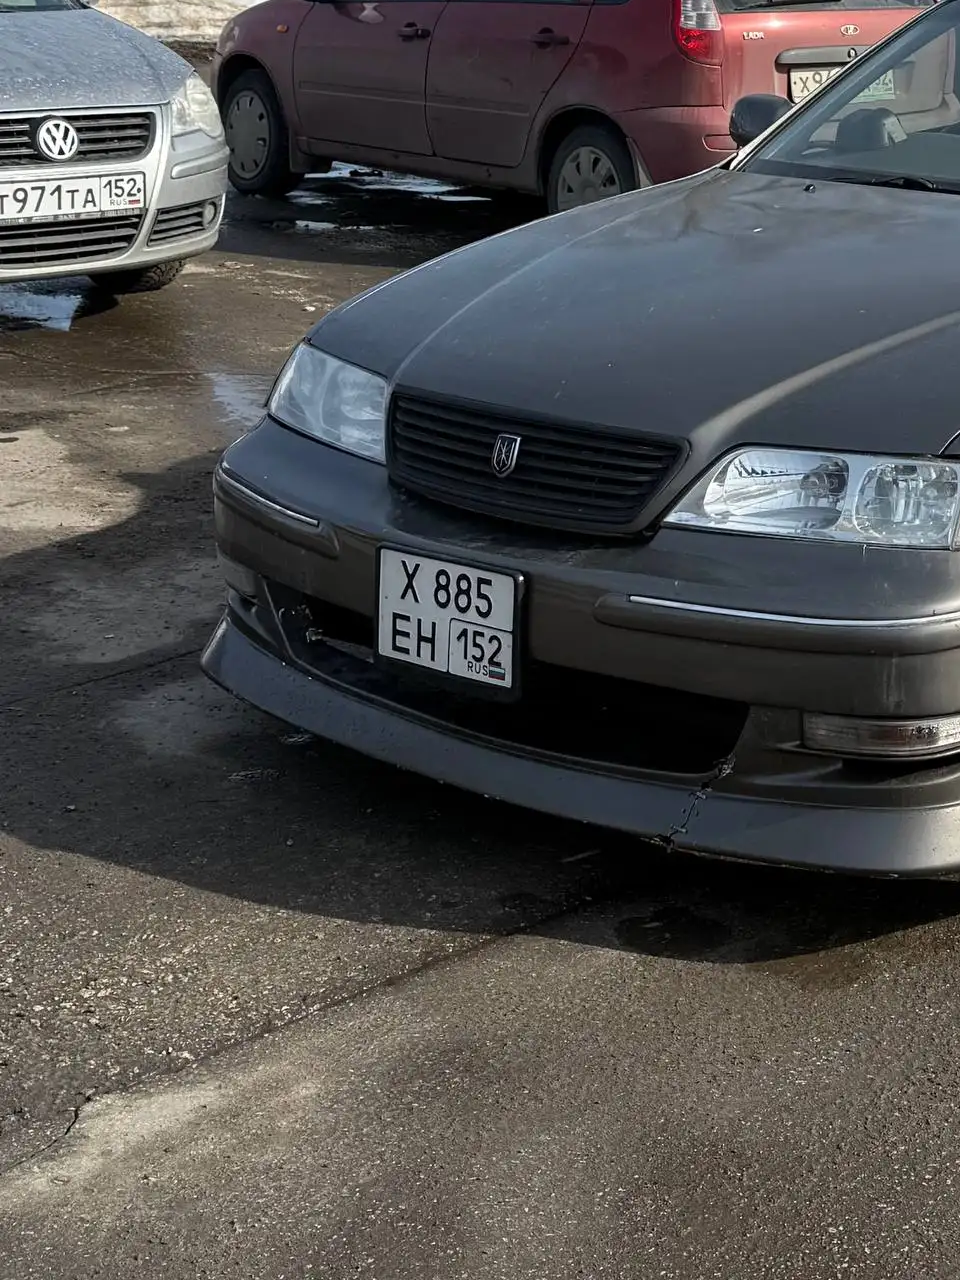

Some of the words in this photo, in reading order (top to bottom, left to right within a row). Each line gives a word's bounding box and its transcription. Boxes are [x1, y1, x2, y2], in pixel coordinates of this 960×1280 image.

[103, 178, 137, 198] 152
[109, 198, 128, 206] RUS
[434, 569, 493, 619] 885
[456, 628, 502, 667] 152
[467, 661, 489, 676] RUS
